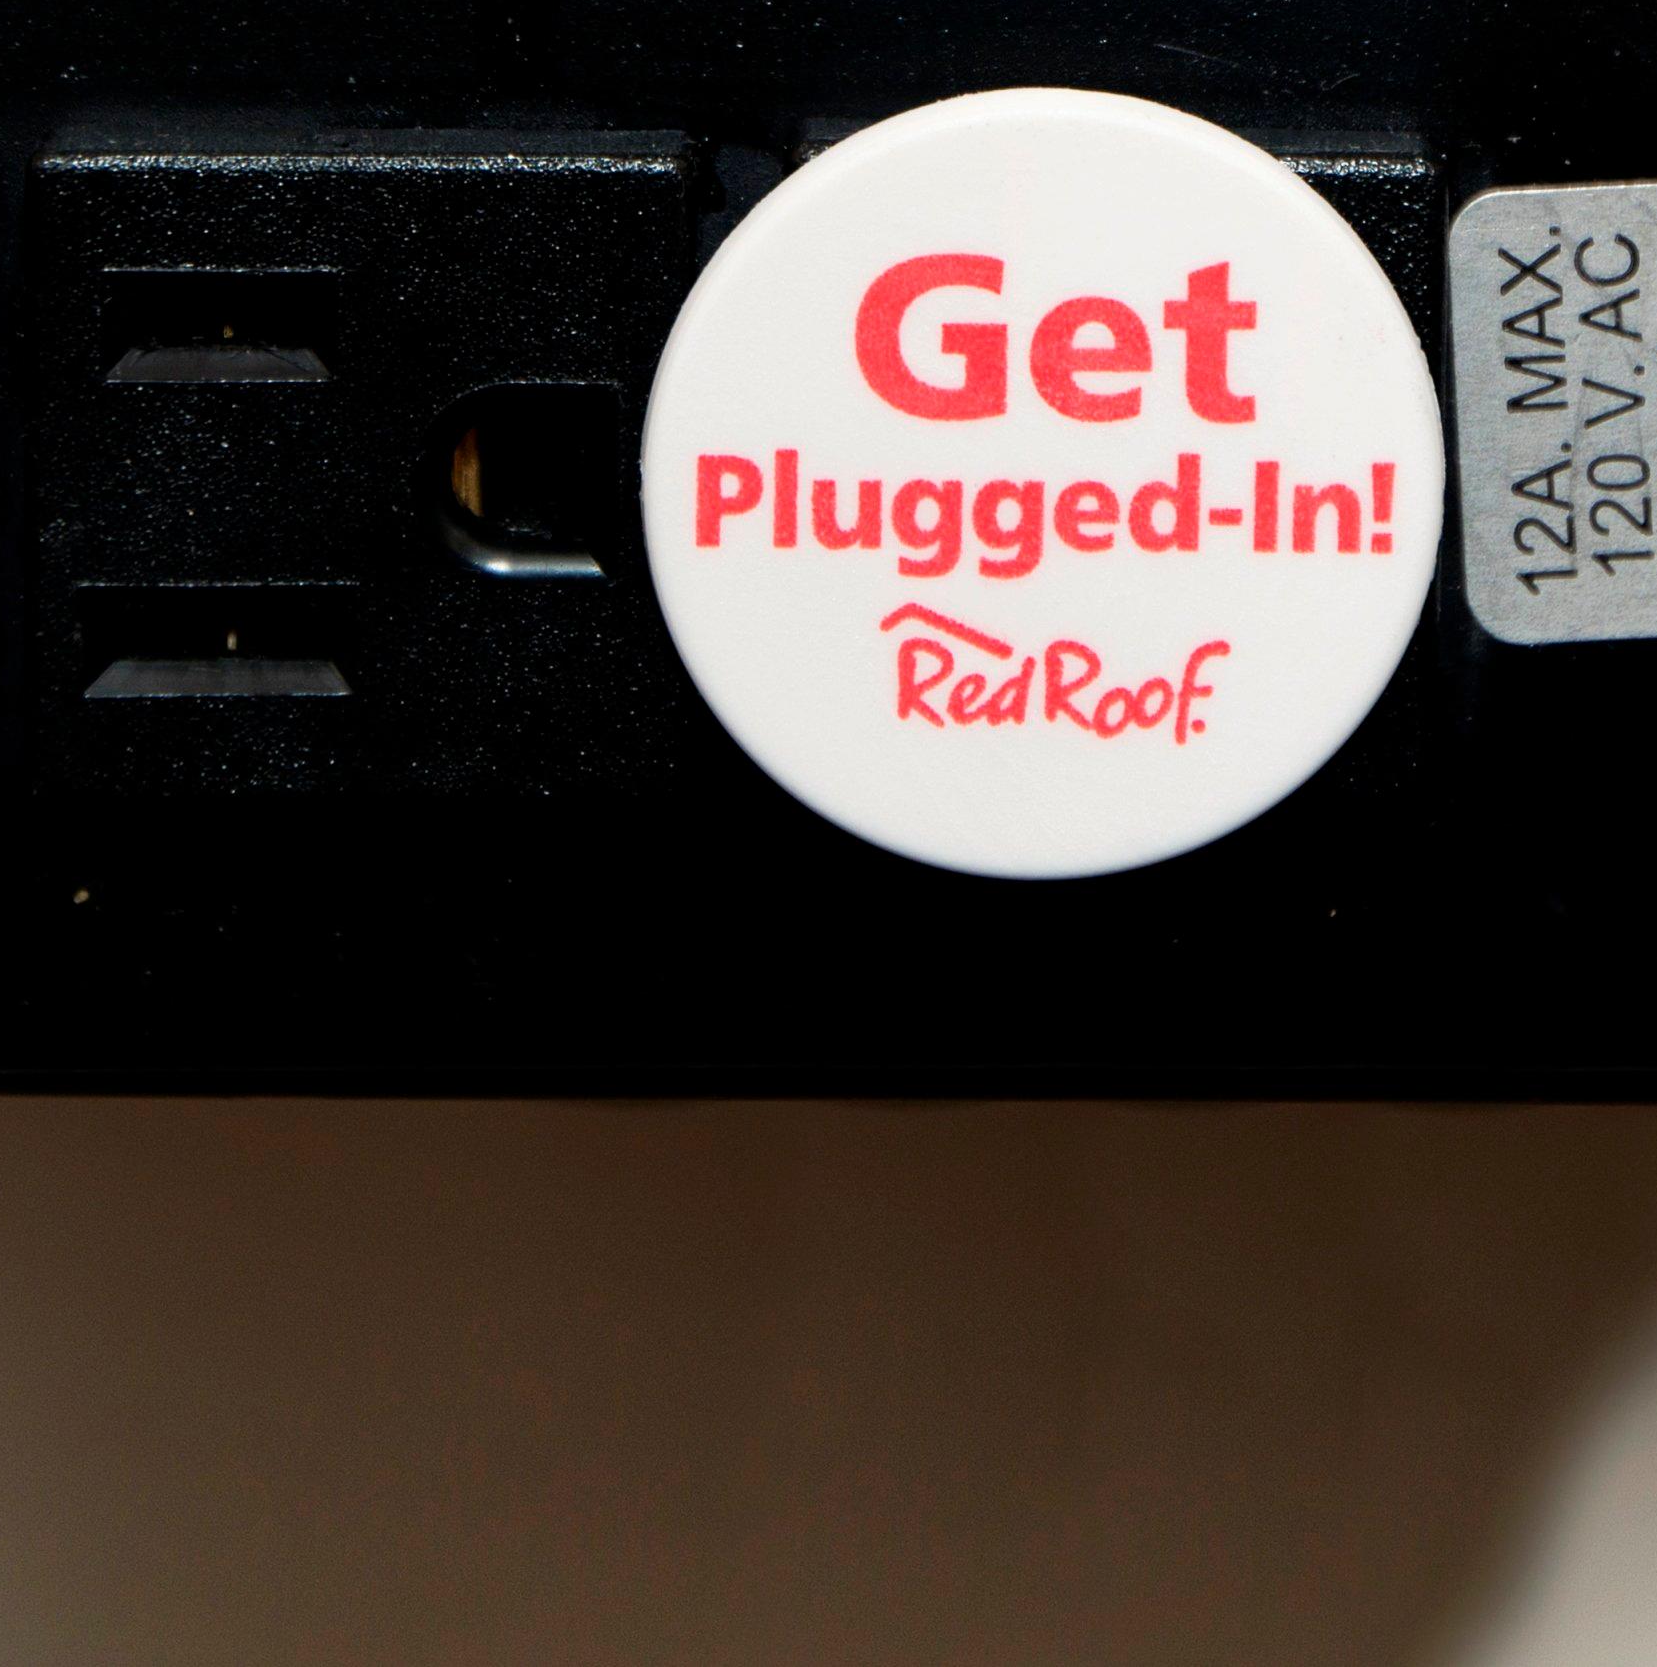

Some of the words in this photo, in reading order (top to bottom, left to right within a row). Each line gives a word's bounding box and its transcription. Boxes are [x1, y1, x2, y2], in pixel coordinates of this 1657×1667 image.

[854, 252, 1258, 425] Get
[1498, 225, 1570, 414] MAX.
[1574, 232, 1643, 343] AC
[695, 448, 1397, 581] Plugged-In!
[1510, 441, 1578, 596] 12A.
[1586, 452, 1655, 577] 120
